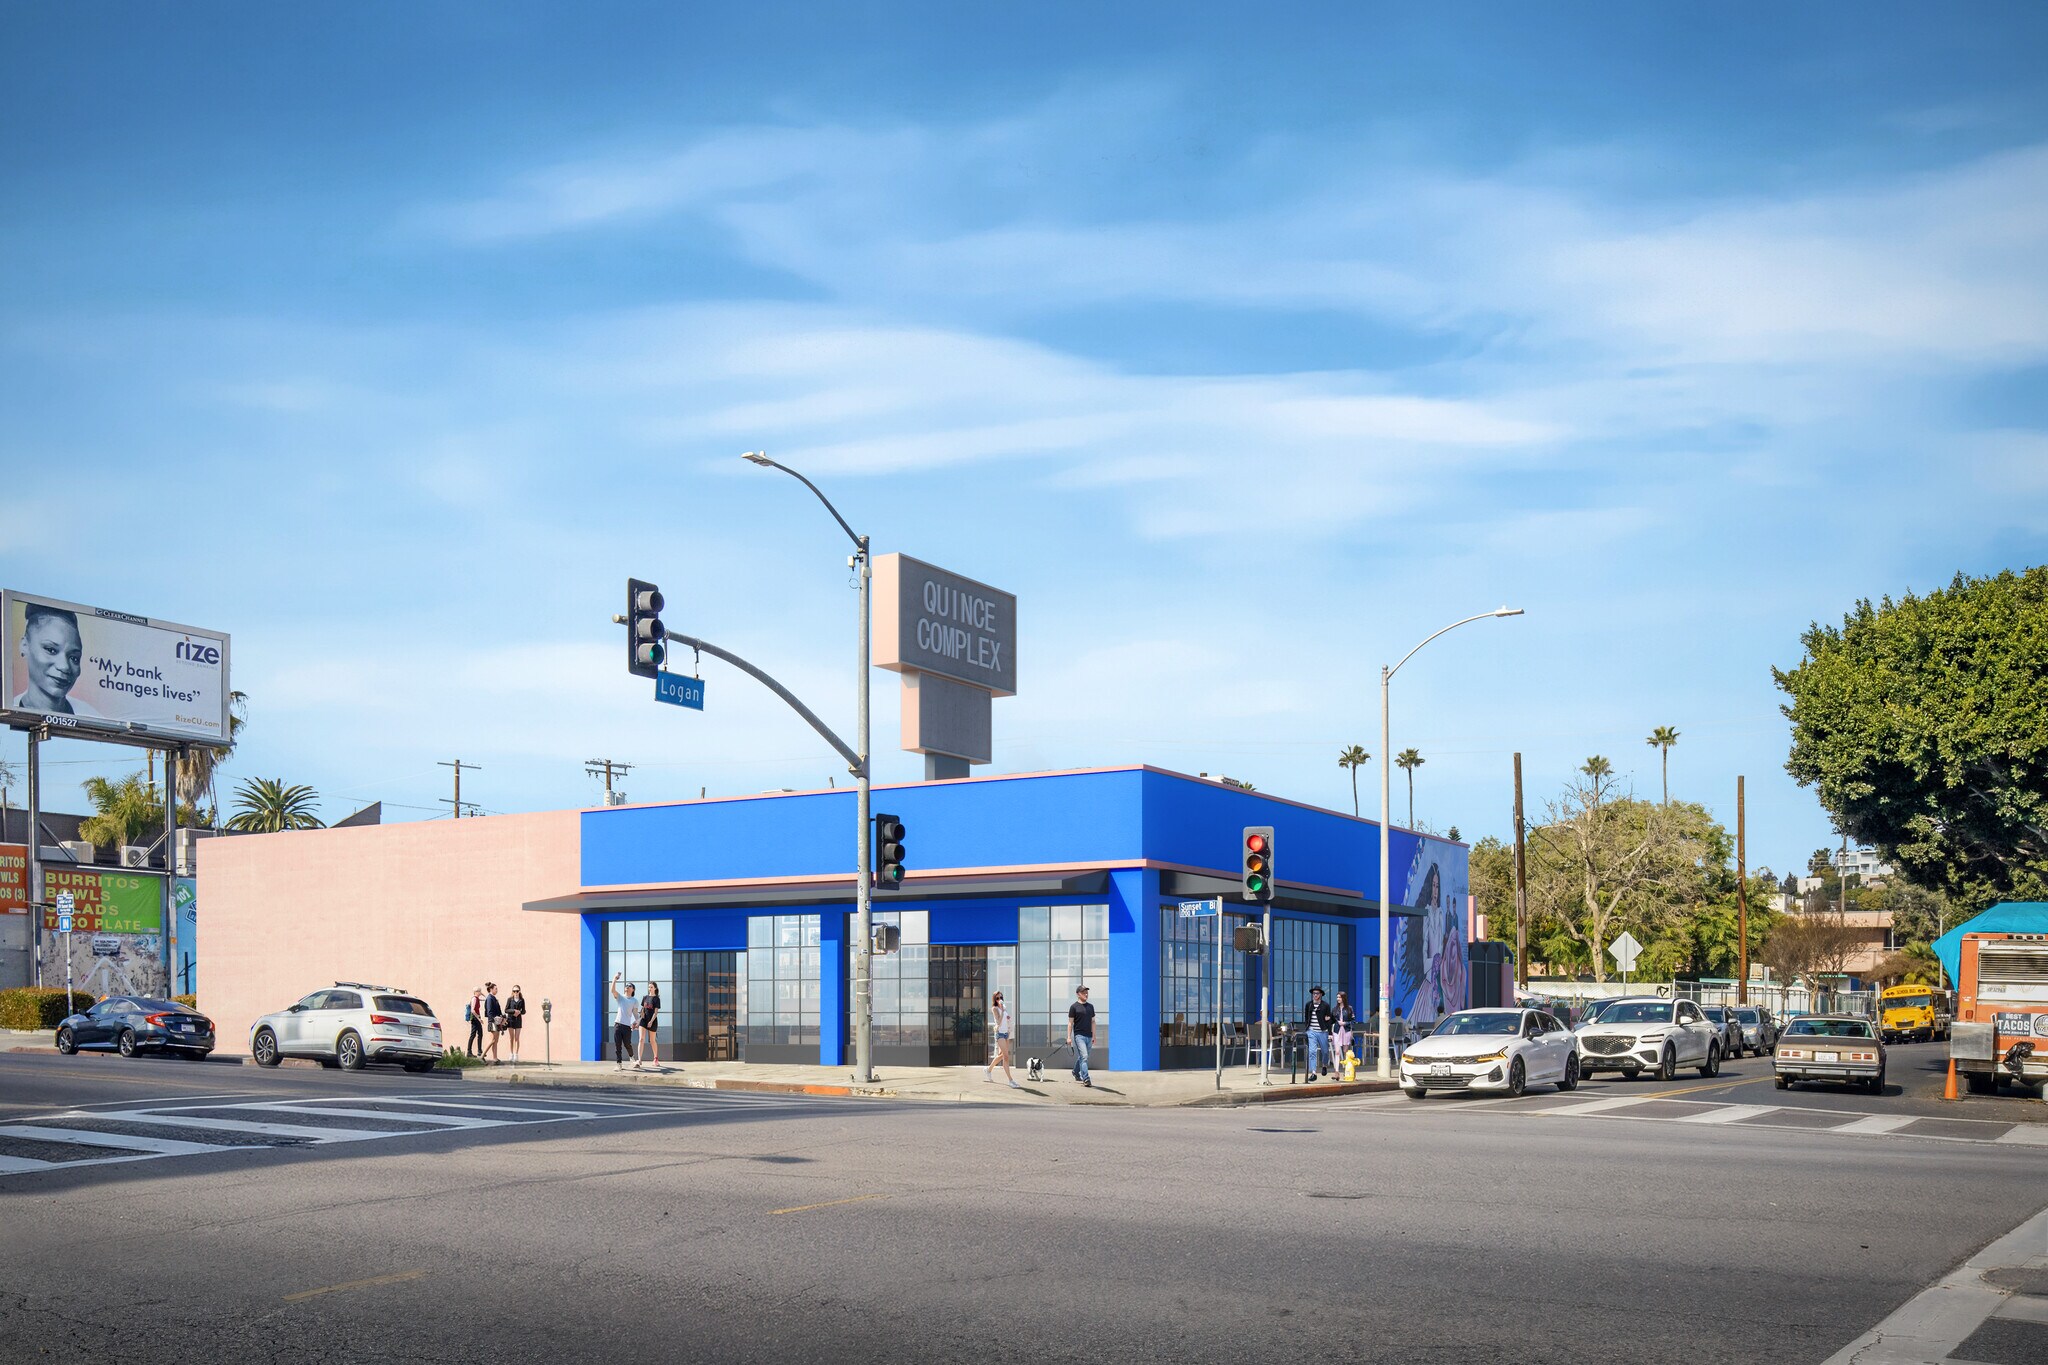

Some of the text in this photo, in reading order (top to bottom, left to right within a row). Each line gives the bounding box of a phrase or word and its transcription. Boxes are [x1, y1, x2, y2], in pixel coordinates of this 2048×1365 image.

[923, 580, 996, 633] QUINCE
[176, 637, 219, 665] rize
[917, 618, 1001, 672] COMPLEX
[126, 661, 162, 681] bank
[99, 675, 158, 698] changes
[661, 678, 699, 702] Logan
[175, 714, 220, 728] RizeCU.com
[45, 872, 140, 889] BURRITOS
[14, 888, 26, 902] (3)
[1180, 902, 1202, 912] Sunset
[94, 917, 141, 931] PLATE
[1998, 1020, 2030, 1031] TACOS
